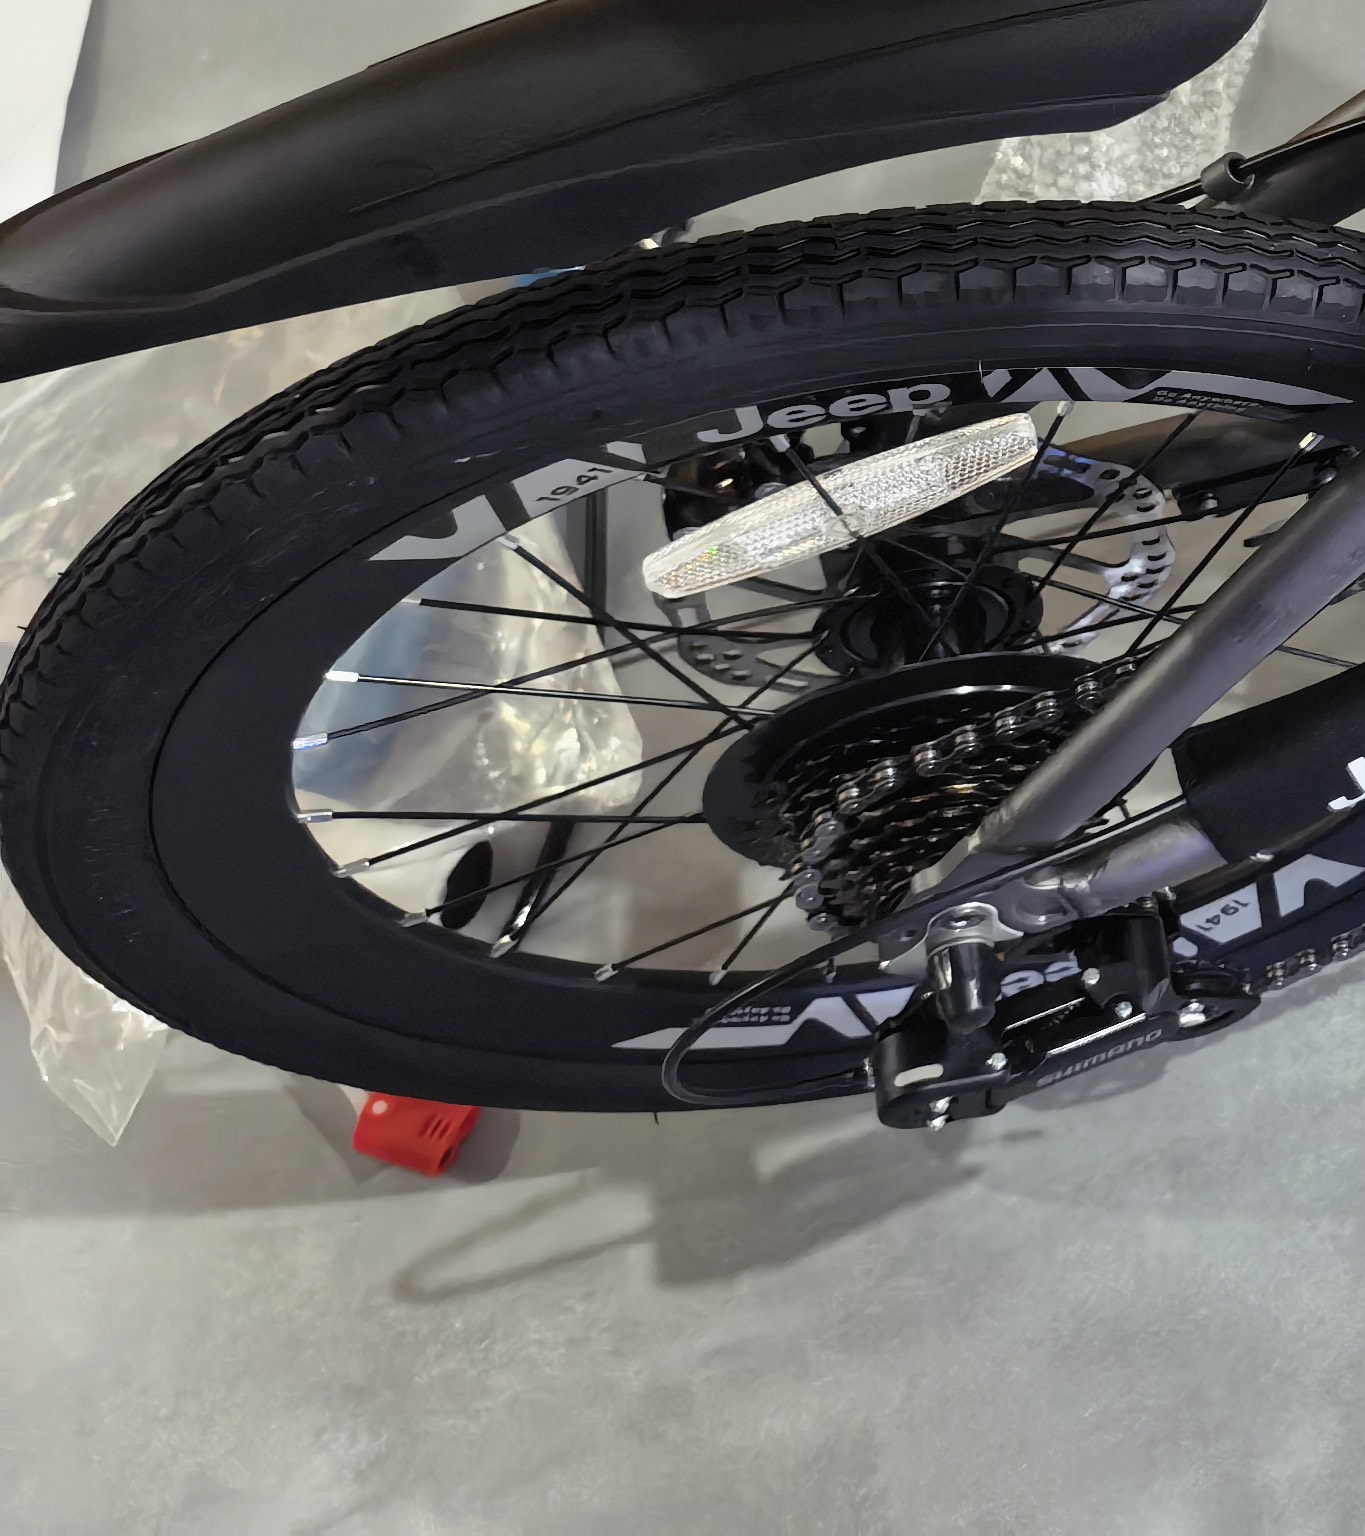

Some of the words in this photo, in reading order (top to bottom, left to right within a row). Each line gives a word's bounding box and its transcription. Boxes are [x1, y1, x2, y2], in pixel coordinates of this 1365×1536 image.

[696, 382, 951, 444] Jeep
[535, 466, 614, 502] 1941
[1195, 898, 1252, 932] 1941
